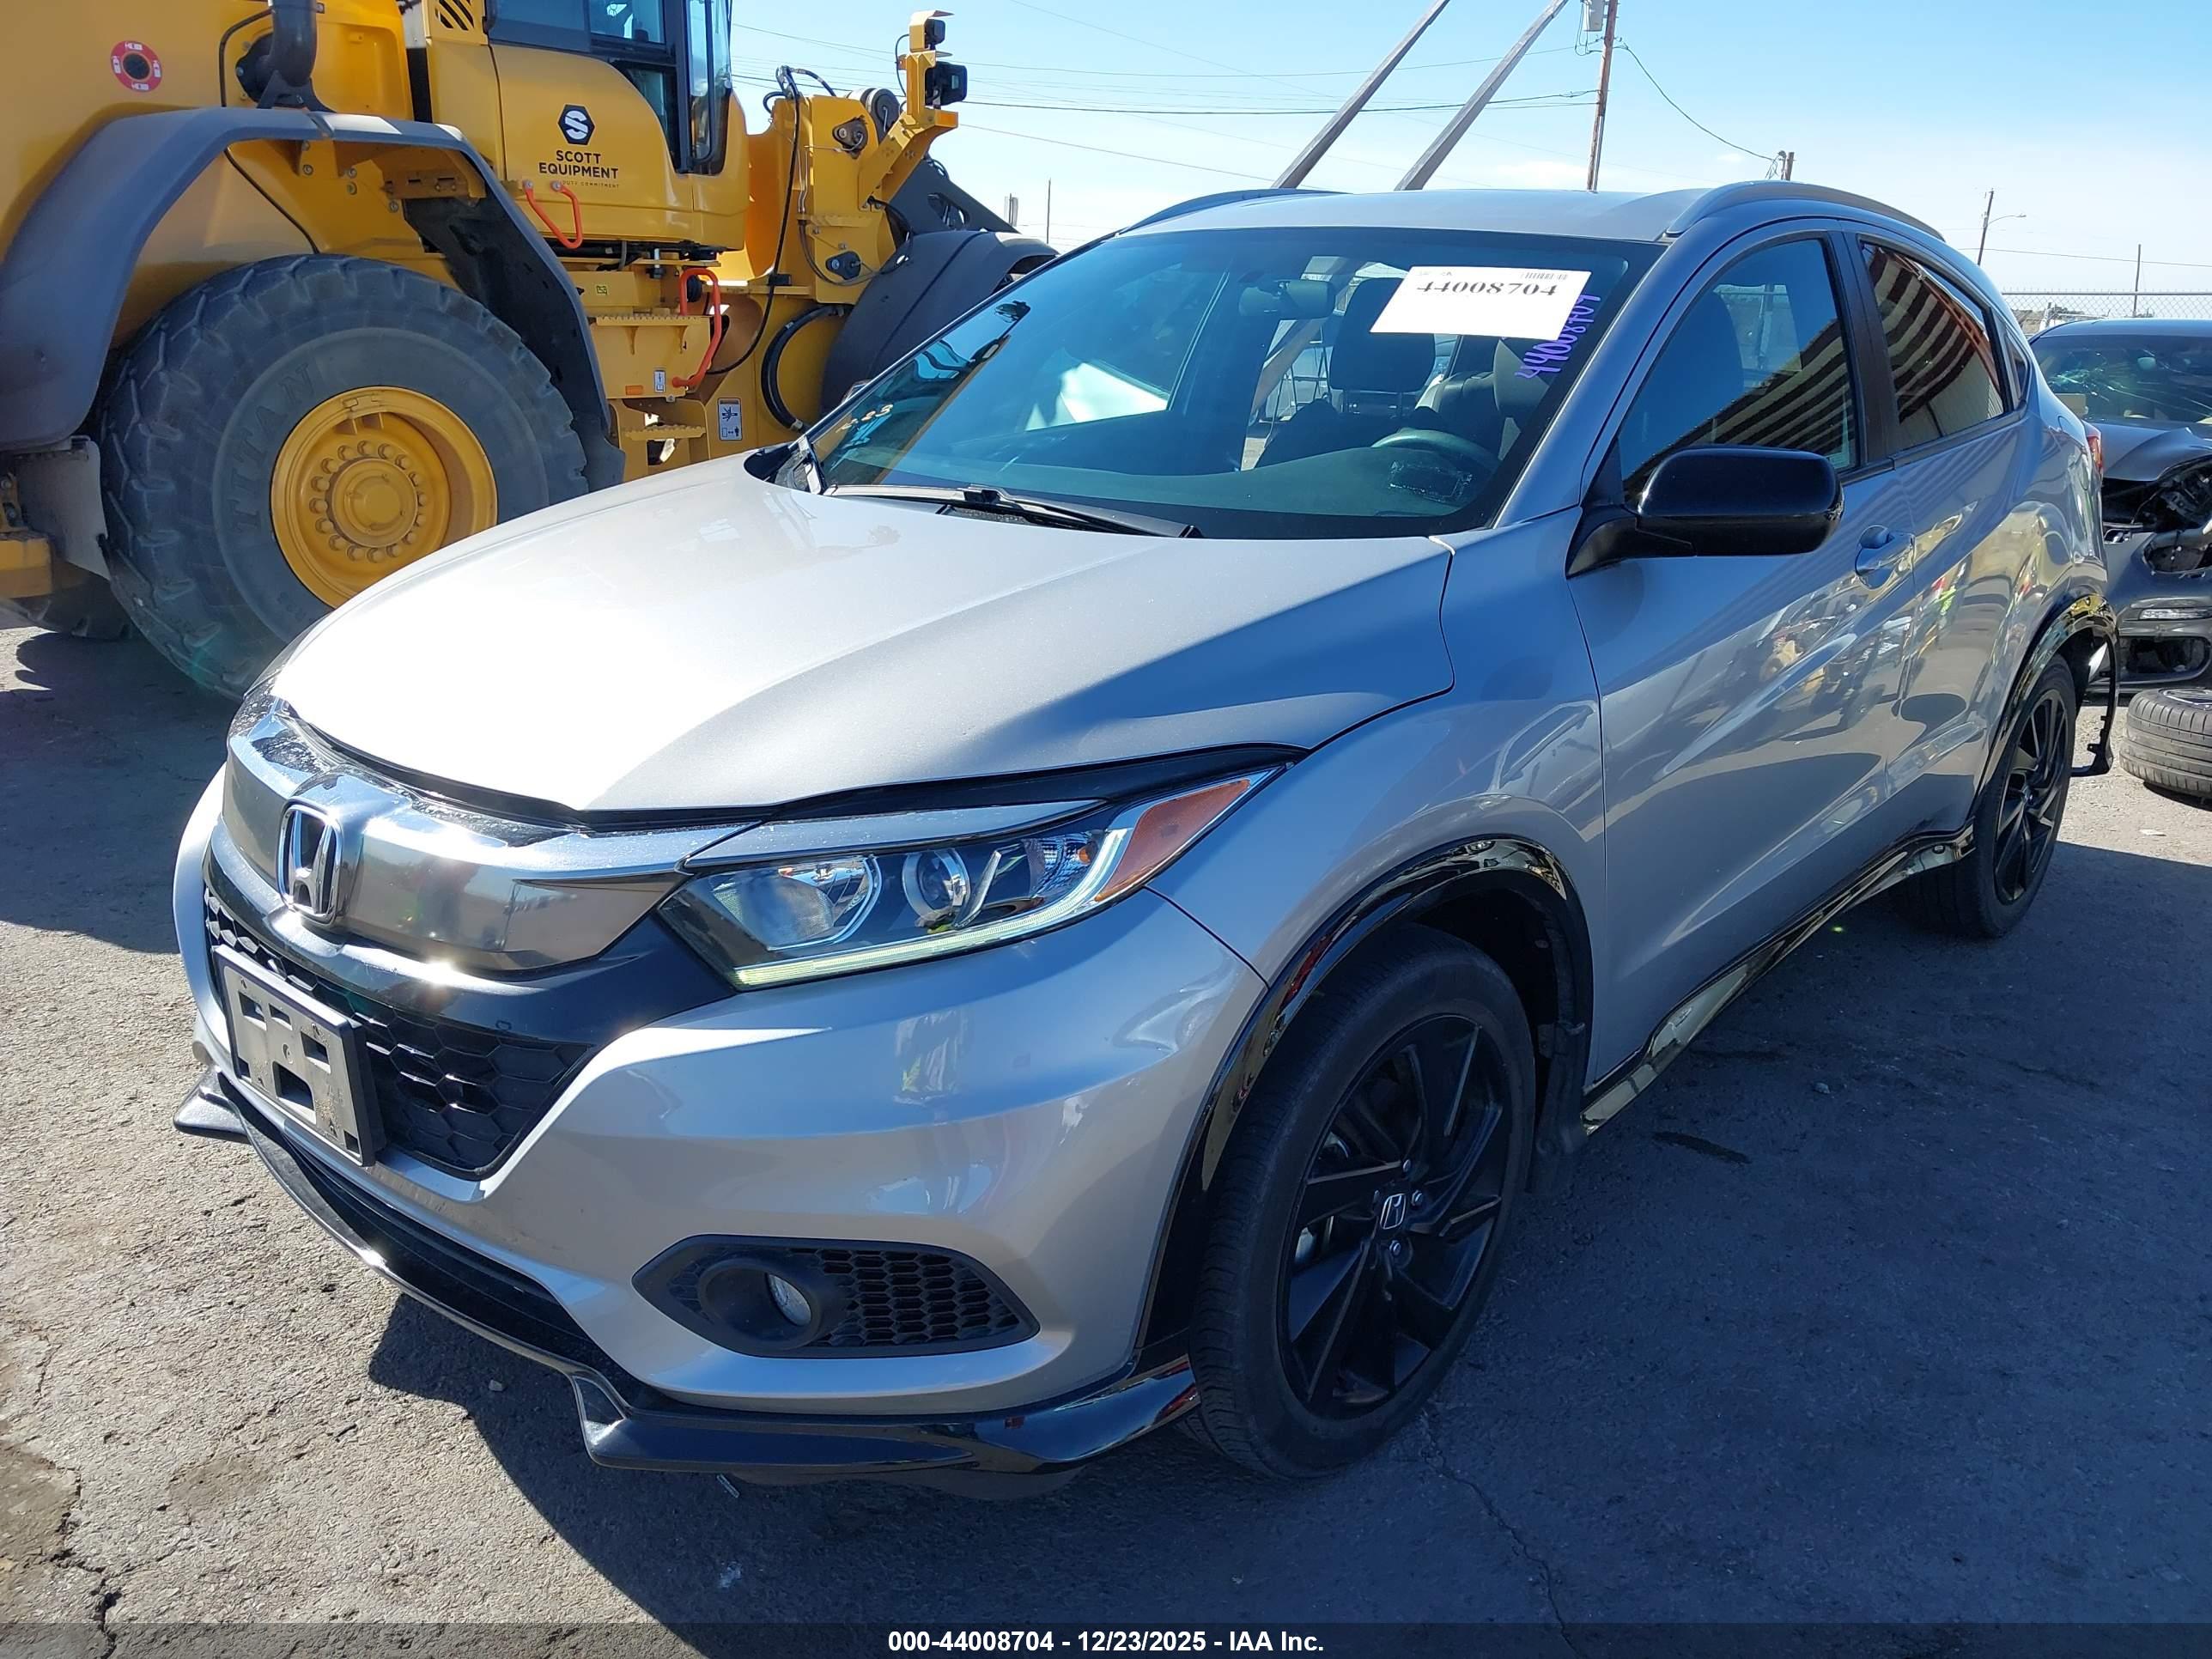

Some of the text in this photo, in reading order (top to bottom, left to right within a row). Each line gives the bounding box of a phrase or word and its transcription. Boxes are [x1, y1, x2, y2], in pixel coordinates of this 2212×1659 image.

[556, 149, 601, 165] SCOTT
[538, 162, 619, 179] EQUIPMENT
[1417, 281, 1558, 296] 44008704
